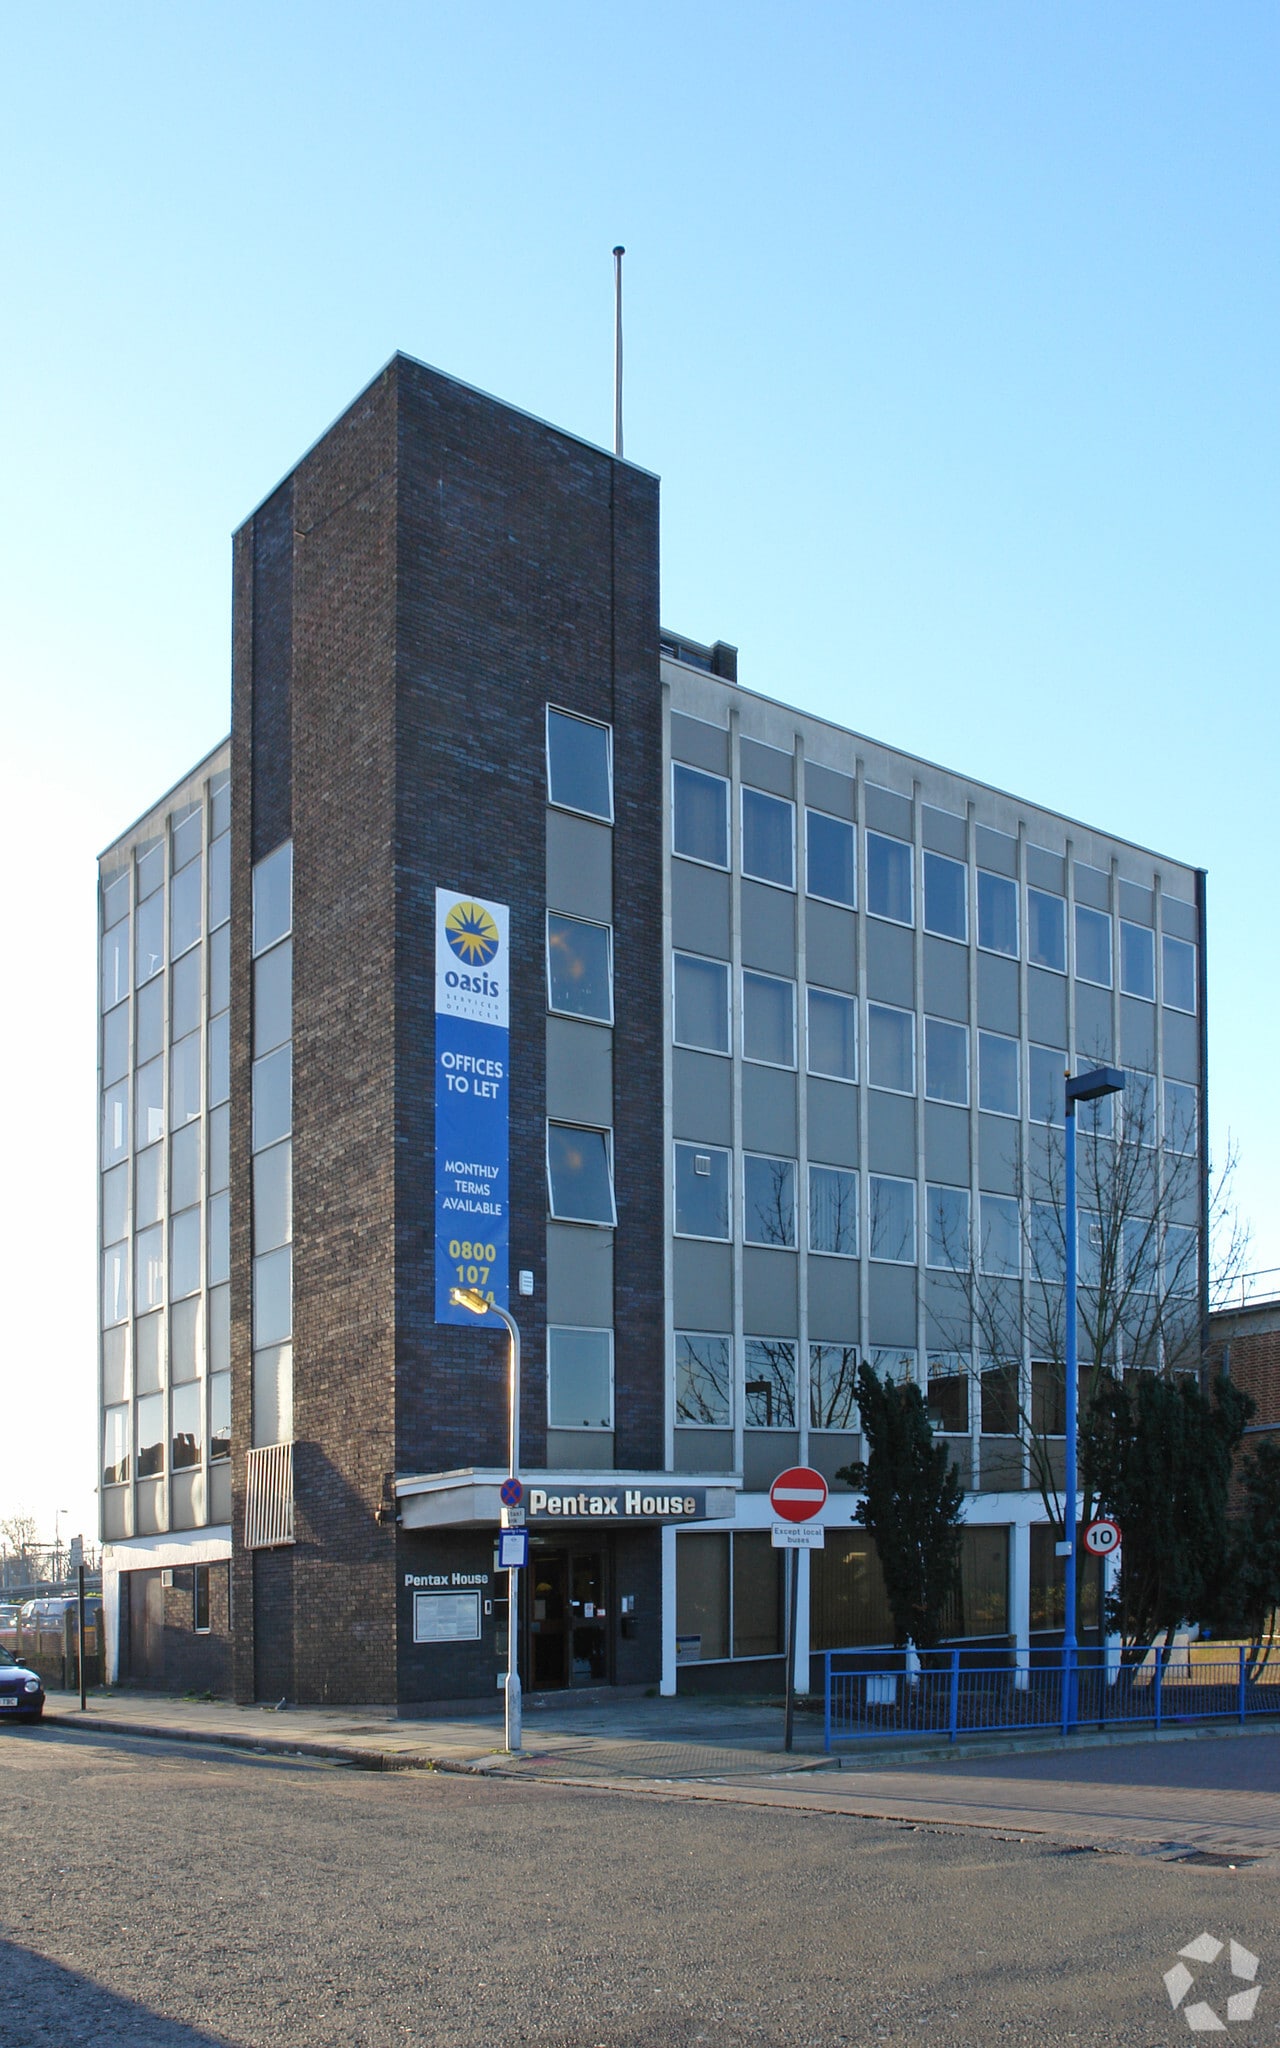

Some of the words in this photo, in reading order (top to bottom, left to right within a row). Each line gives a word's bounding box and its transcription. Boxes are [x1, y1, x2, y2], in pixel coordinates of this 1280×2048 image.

[445, 971, 499, 998] oasis
[441, 1051, 503, 1078] OFFICES
[445, 1074, 469, 1093] TO
[474, 1079, 500, 1099] LET
[445, 1160, 499, 1179] MONTHLY
[454, 1179, 491, 1196] TERMS
[442, 1197, 502, 1216] AVAILABLE
[449, 1239, 496, 1262] 0800
[456, 1265, 490, 1285] 107
[529, 1489, 619, 1515] Pentax
[625, 1490, 697, 1515] House
[774, 1527, 801, 1536] Except
[803, 1528, 822, 1536] local
[1091, 1530, 1113, 1545] 10
[404, 1574, 449, 1587] Pentax
[451, 1572, 489, 1585] House
